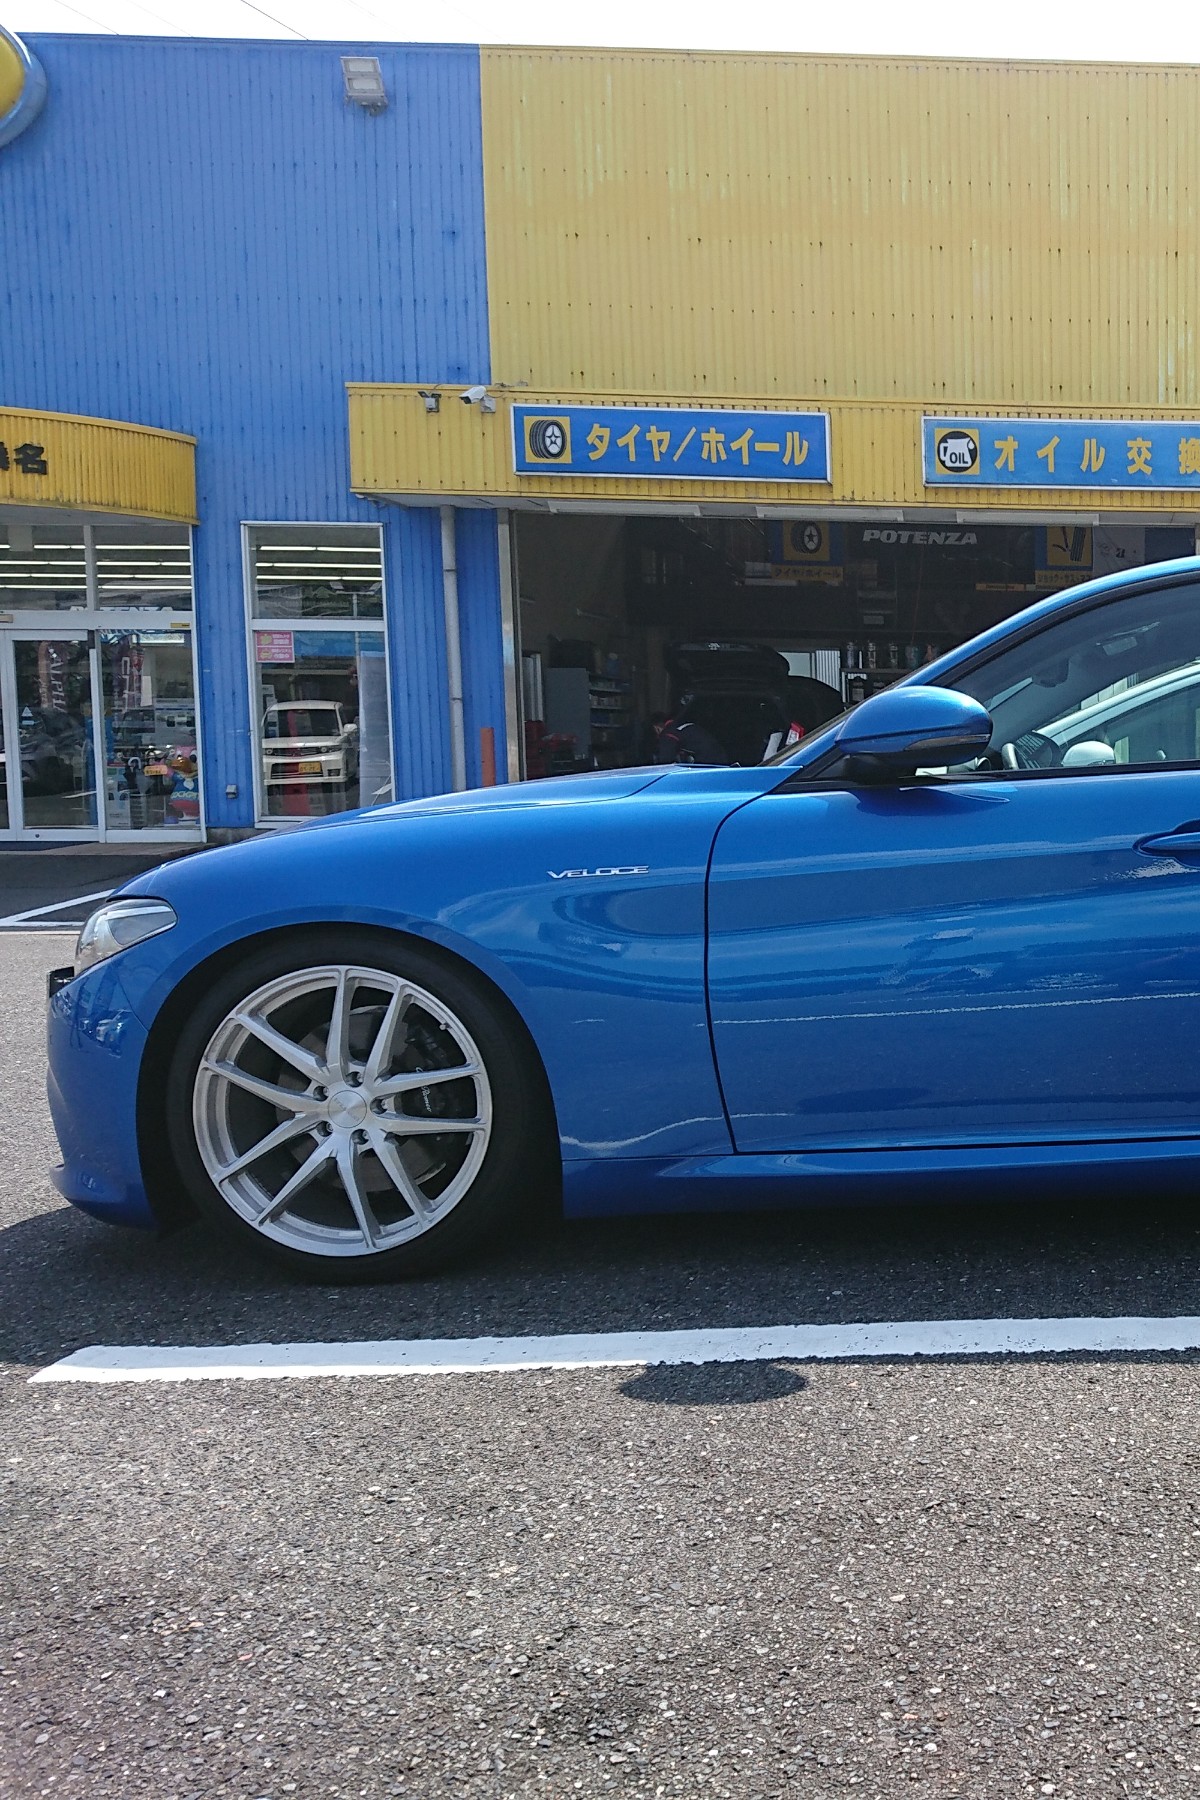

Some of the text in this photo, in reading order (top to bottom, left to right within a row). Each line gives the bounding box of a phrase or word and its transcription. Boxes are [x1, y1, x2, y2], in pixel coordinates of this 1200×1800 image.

[585, 423, 809, 466] タイヤ/ホイール
[0, 441, 48, 475] 名
[949, 452, 969, 465] OIL
[862, 529, 978, 546] POTENZA
[546, 865, 649, 879] VELOCE
